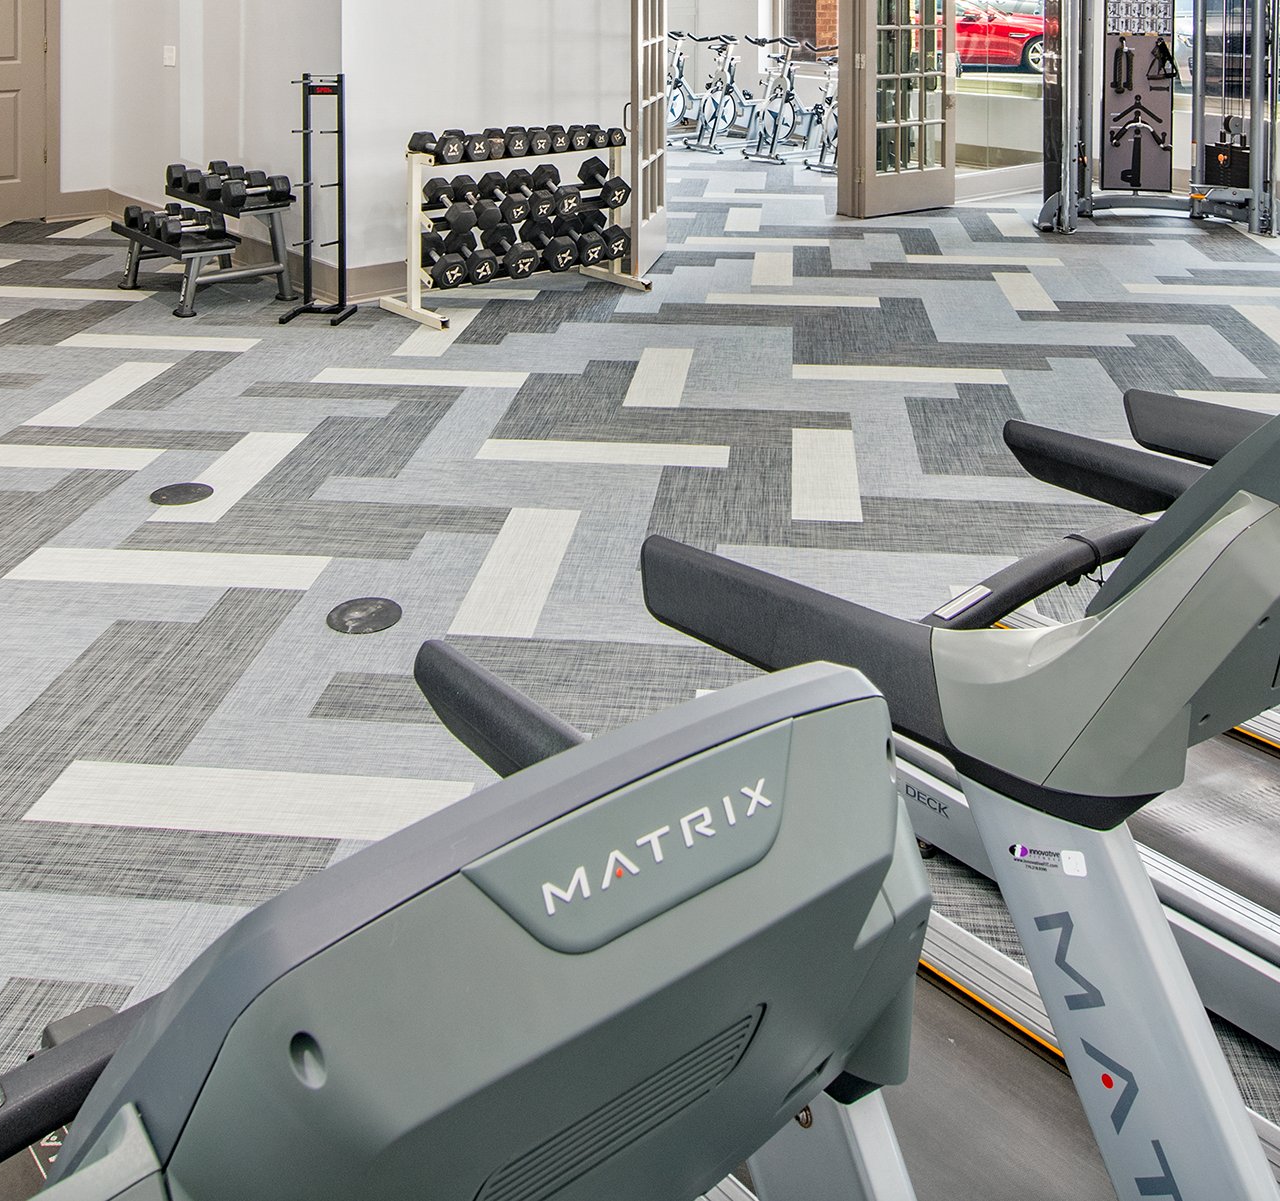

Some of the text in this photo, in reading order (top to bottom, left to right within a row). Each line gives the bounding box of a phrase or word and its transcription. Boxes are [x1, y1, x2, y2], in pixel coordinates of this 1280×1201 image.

[905, 783, 950, 820] DECK
[541, 777, 773, 917] MATRIX
[1029, 848, 1060, 858] innovative
